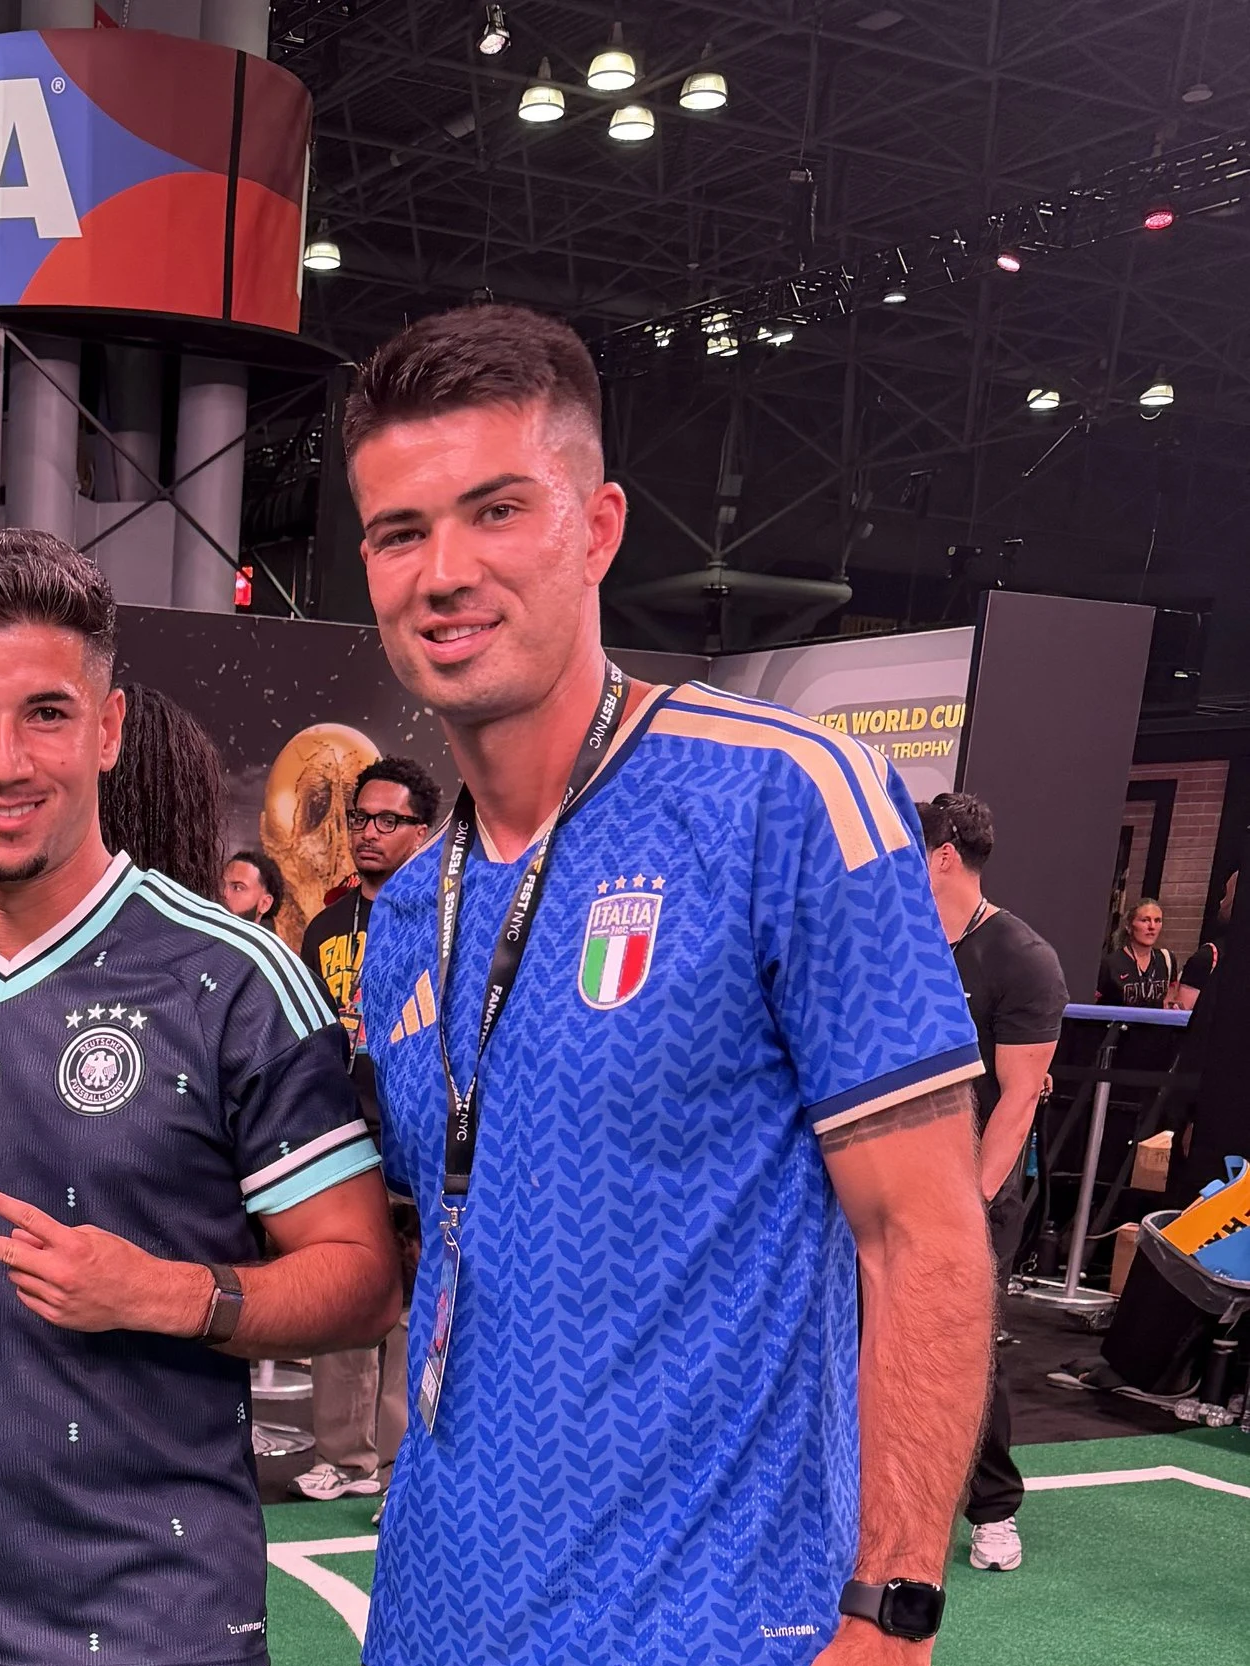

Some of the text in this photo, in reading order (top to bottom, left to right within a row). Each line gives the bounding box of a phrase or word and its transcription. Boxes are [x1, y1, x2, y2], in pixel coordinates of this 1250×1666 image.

[602, 693, 618, 725] FEST
[852, 707, 928, 735] WORLD
[589, 721, 607, 750] NYC
[892, 739, 955, 760] TROPHY
[448, 844, 465, 875] FEST
[458, 820, 469, 845] NYC
[506, 874, 537, 942] FEST NYC
[593, 902, 652, 927] ITALIA
[80, 1038, 125, 1054] DEUTSCHER
[456, 1112, 469, 1142] NYC
